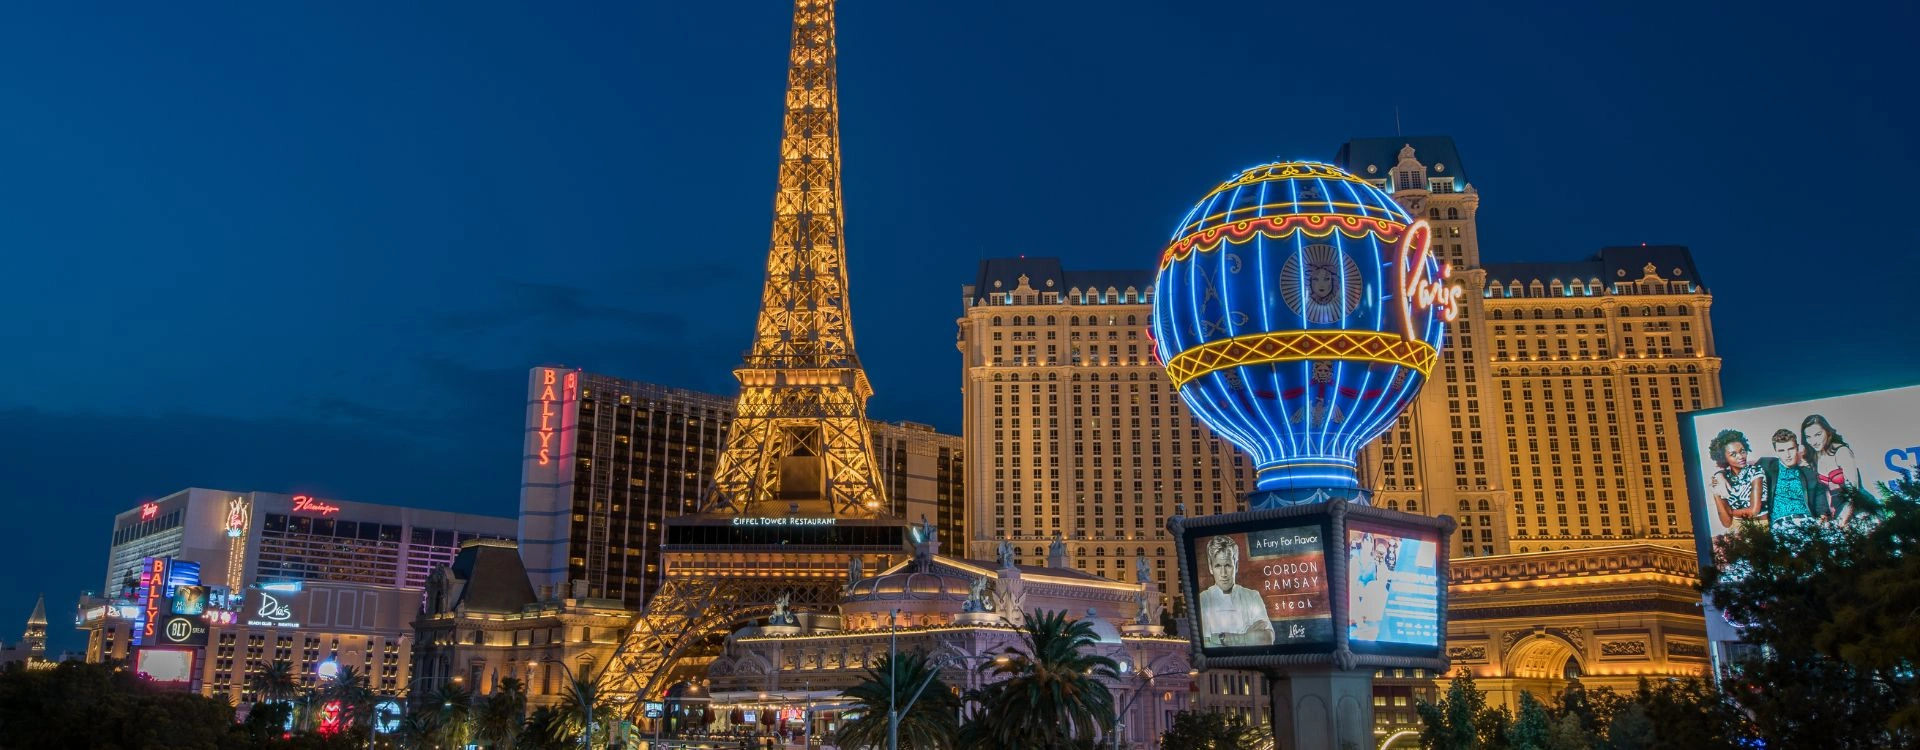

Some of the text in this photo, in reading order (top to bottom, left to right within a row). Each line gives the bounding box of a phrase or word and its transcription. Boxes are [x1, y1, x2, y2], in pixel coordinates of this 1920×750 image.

[1400, 219, 1462, 342] Paris
[538, 369, 556, 465] BALLYS
[292, 495, 340, 515] Flamingo
[733, 517, 836, 525] EIFFEL TOWER RESTAURANT
[1256, 535, 1318, 549] A Fury For Flavor
[1263, 562, 1318, 576] GORDON
[1264, 576, 1318, 591] RAMSAY
[145, 560, 164, 636] BALLYS
[1274, 598, 1313, 611] steak
[172, 622, 188, 637] BLT
